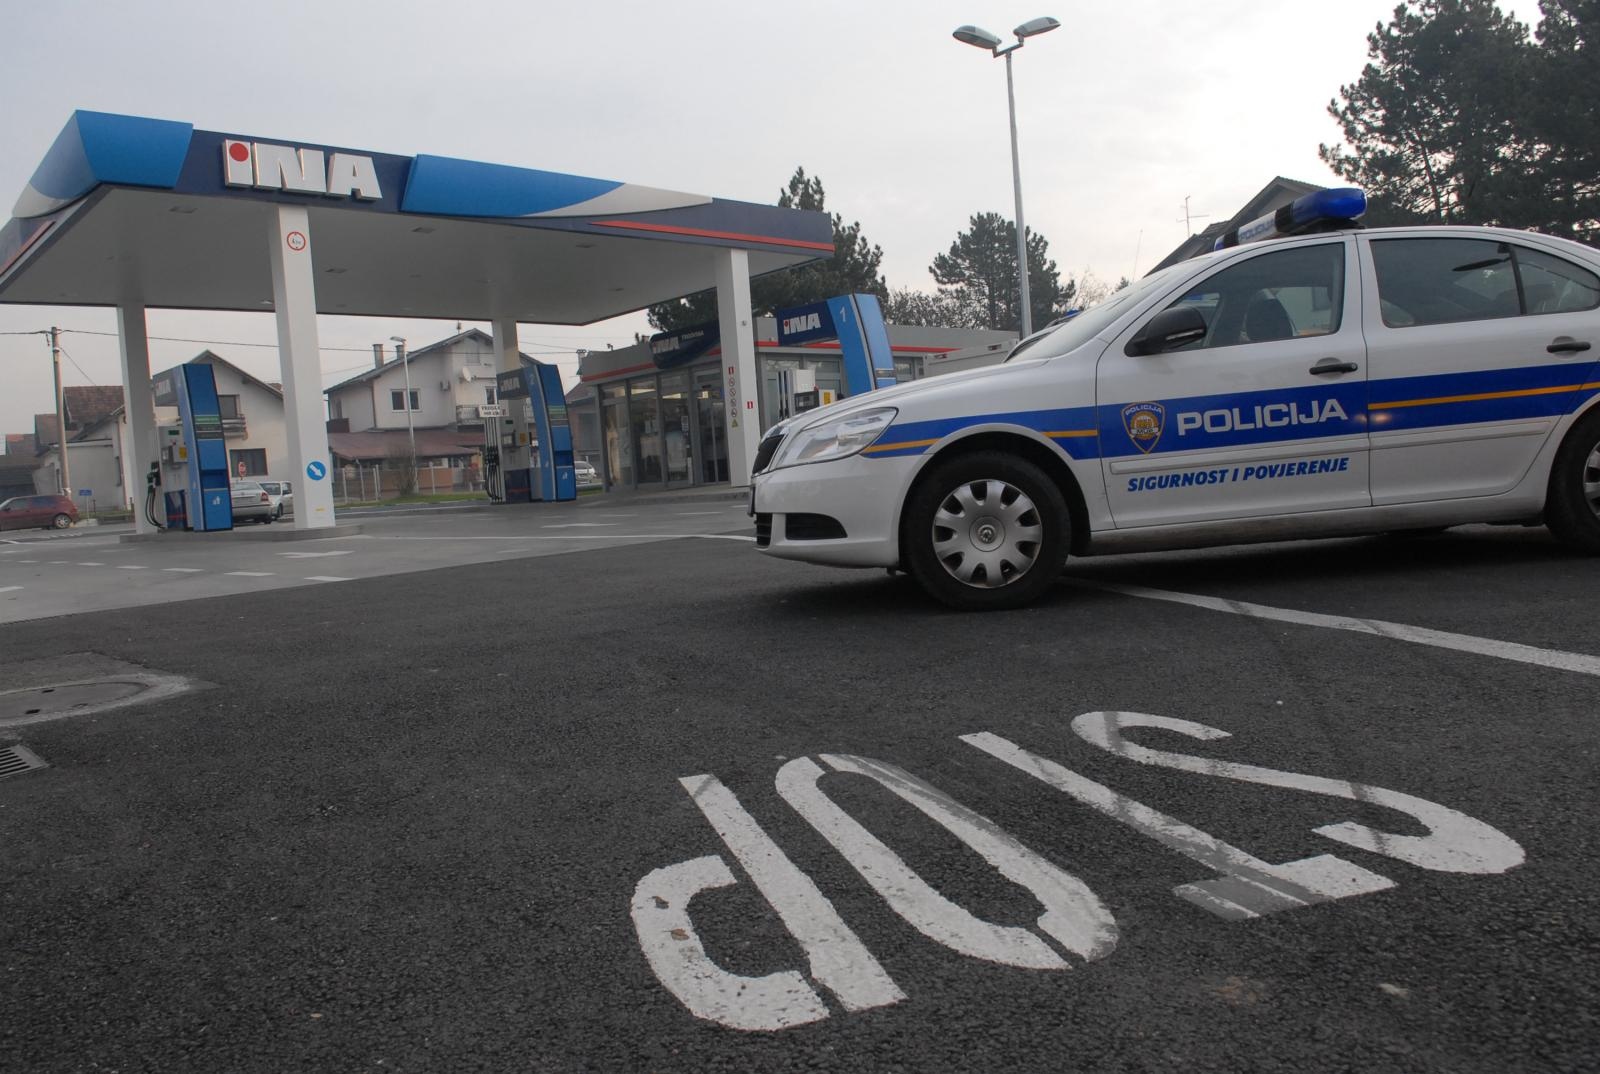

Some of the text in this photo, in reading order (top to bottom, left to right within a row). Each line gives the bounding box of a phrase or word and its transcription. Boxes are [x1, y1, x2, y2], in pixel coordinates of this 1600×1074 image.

[1177, 399, 1348, 436] POLICIJA
[1127, 457, 1350, 492] SIGURNOST I POVJERENJE
[630, 711, 1526, 1032] STOP
